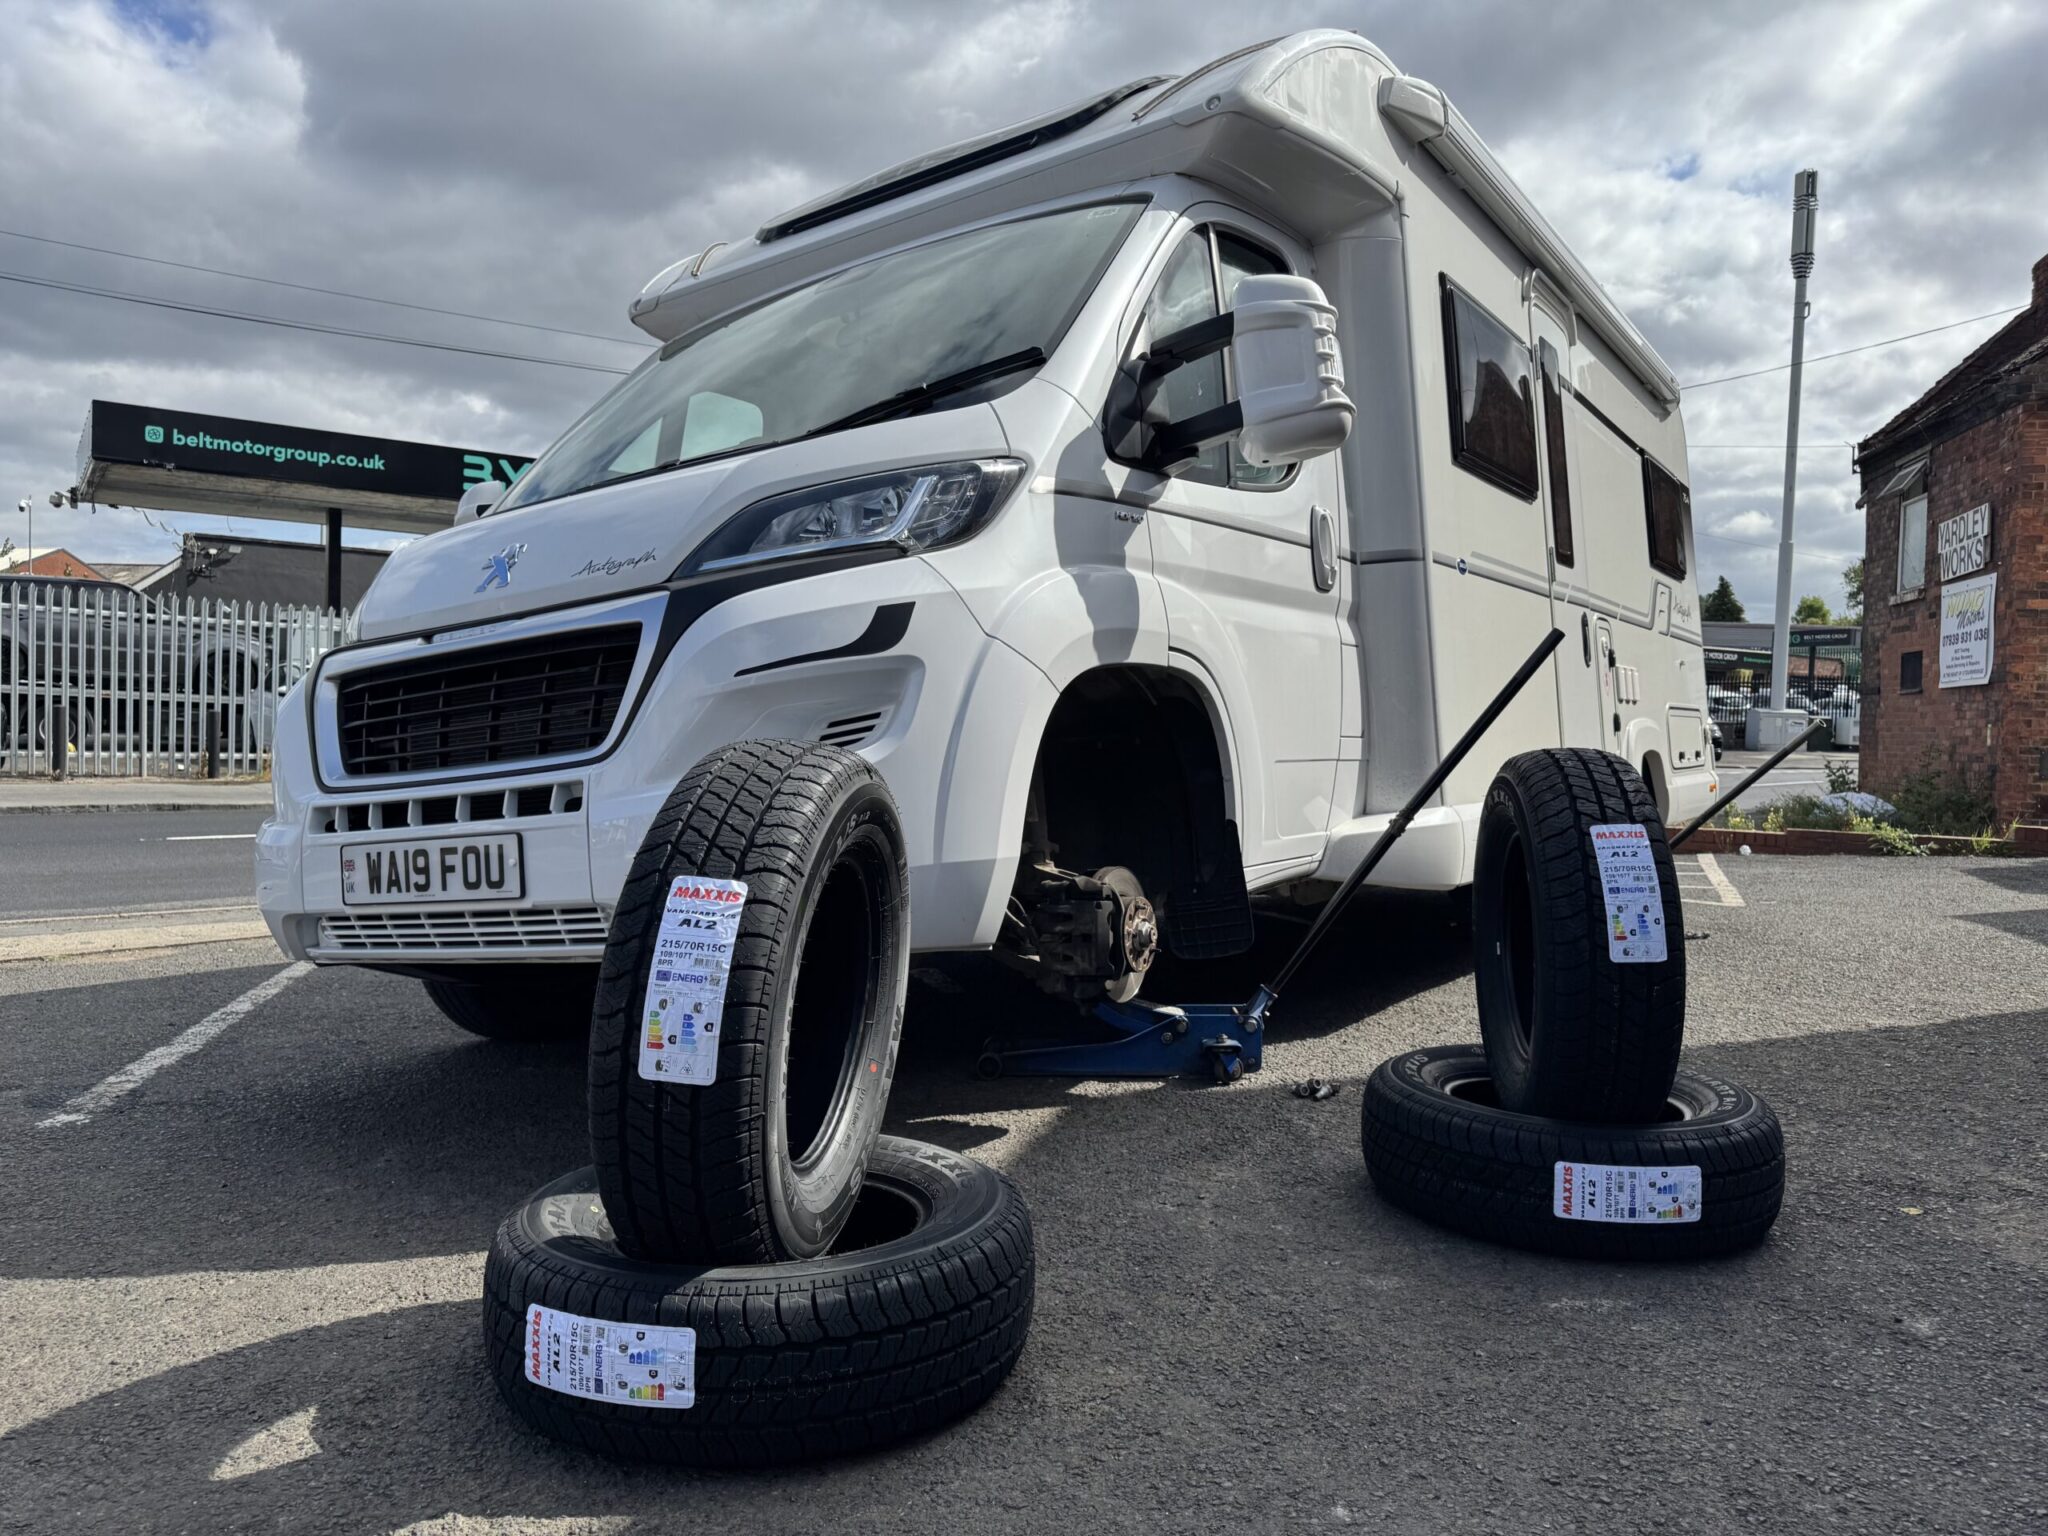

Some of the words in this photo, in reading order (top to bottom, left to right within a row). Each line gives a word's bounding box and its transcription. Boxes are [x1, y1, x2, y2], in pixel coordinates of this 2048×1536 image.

[173, 429, 385, 470] beltmotorgroup.co.uk
[1939, 505, 1987, 551] YARDLEY
[571, 548, 656, 577] Autograph
[1940, 538, 1983, 579] WORKS
[1961, 631, 1971, 644] 931
[1596, 831, 1645, 839] MAXXIS
[366, 849, 431, 894] WA19
[439, 844, 505, 892] FOU
[1603, 865, 1652, 873] 215/70R15C
[346, 881, 355, 894] UK
[673, 886, 744, 904] MAXXIS
[666, 908, 717, 918] VANSMART
[677, 918, 717, 930] AL2
[660, 950, 692, 961] 109/107T
[661, 938, 727, 954] 215/70R15C
[657, 958, 673, 967] 8PR
[672, 972, 704, 984] ENERG
[1562, 1165, 1573, 1216] MAXXIS
[1588, 1179, 1596, 1208] AL2
[1605, 1170, 1613, 1219] 215/70R15C
[532, 1309, 542, 1381] MAXXIS
[553, 1332, 561, 1374] AL2
[569, 1322, 579, 1391] 215/70R15C
[595, 1344, 603, 1378] ENERG
